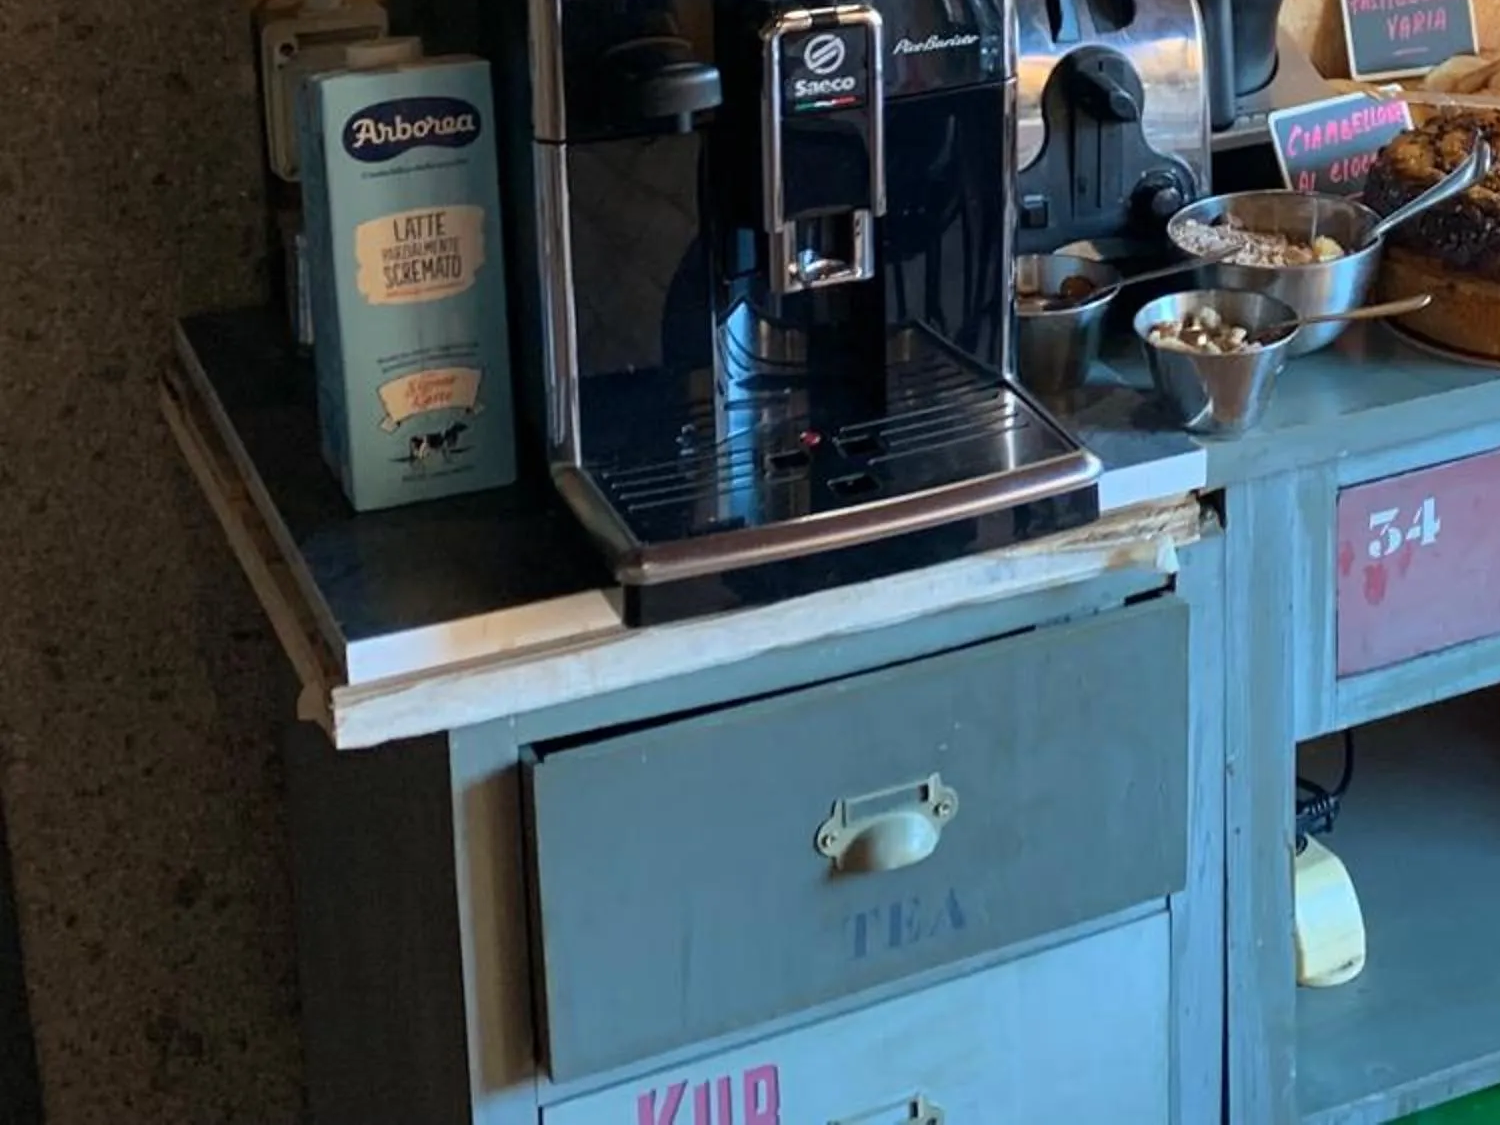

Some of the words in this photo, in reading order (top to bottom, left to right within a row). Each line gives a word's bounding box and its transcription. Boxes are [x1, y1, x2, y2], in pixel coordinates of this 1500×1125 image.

[1387, 7, 1447, 42] VARIA
[794, 77, 856, 97] Saeco
[352, 113, 476, 148] Arborea
[393, 211, 447, 243] LATTE
[383, 254, 463, 290] SCREMATO
[1368, 496, 1441, 560] 34
[842, 887, 966, 960] TEA
